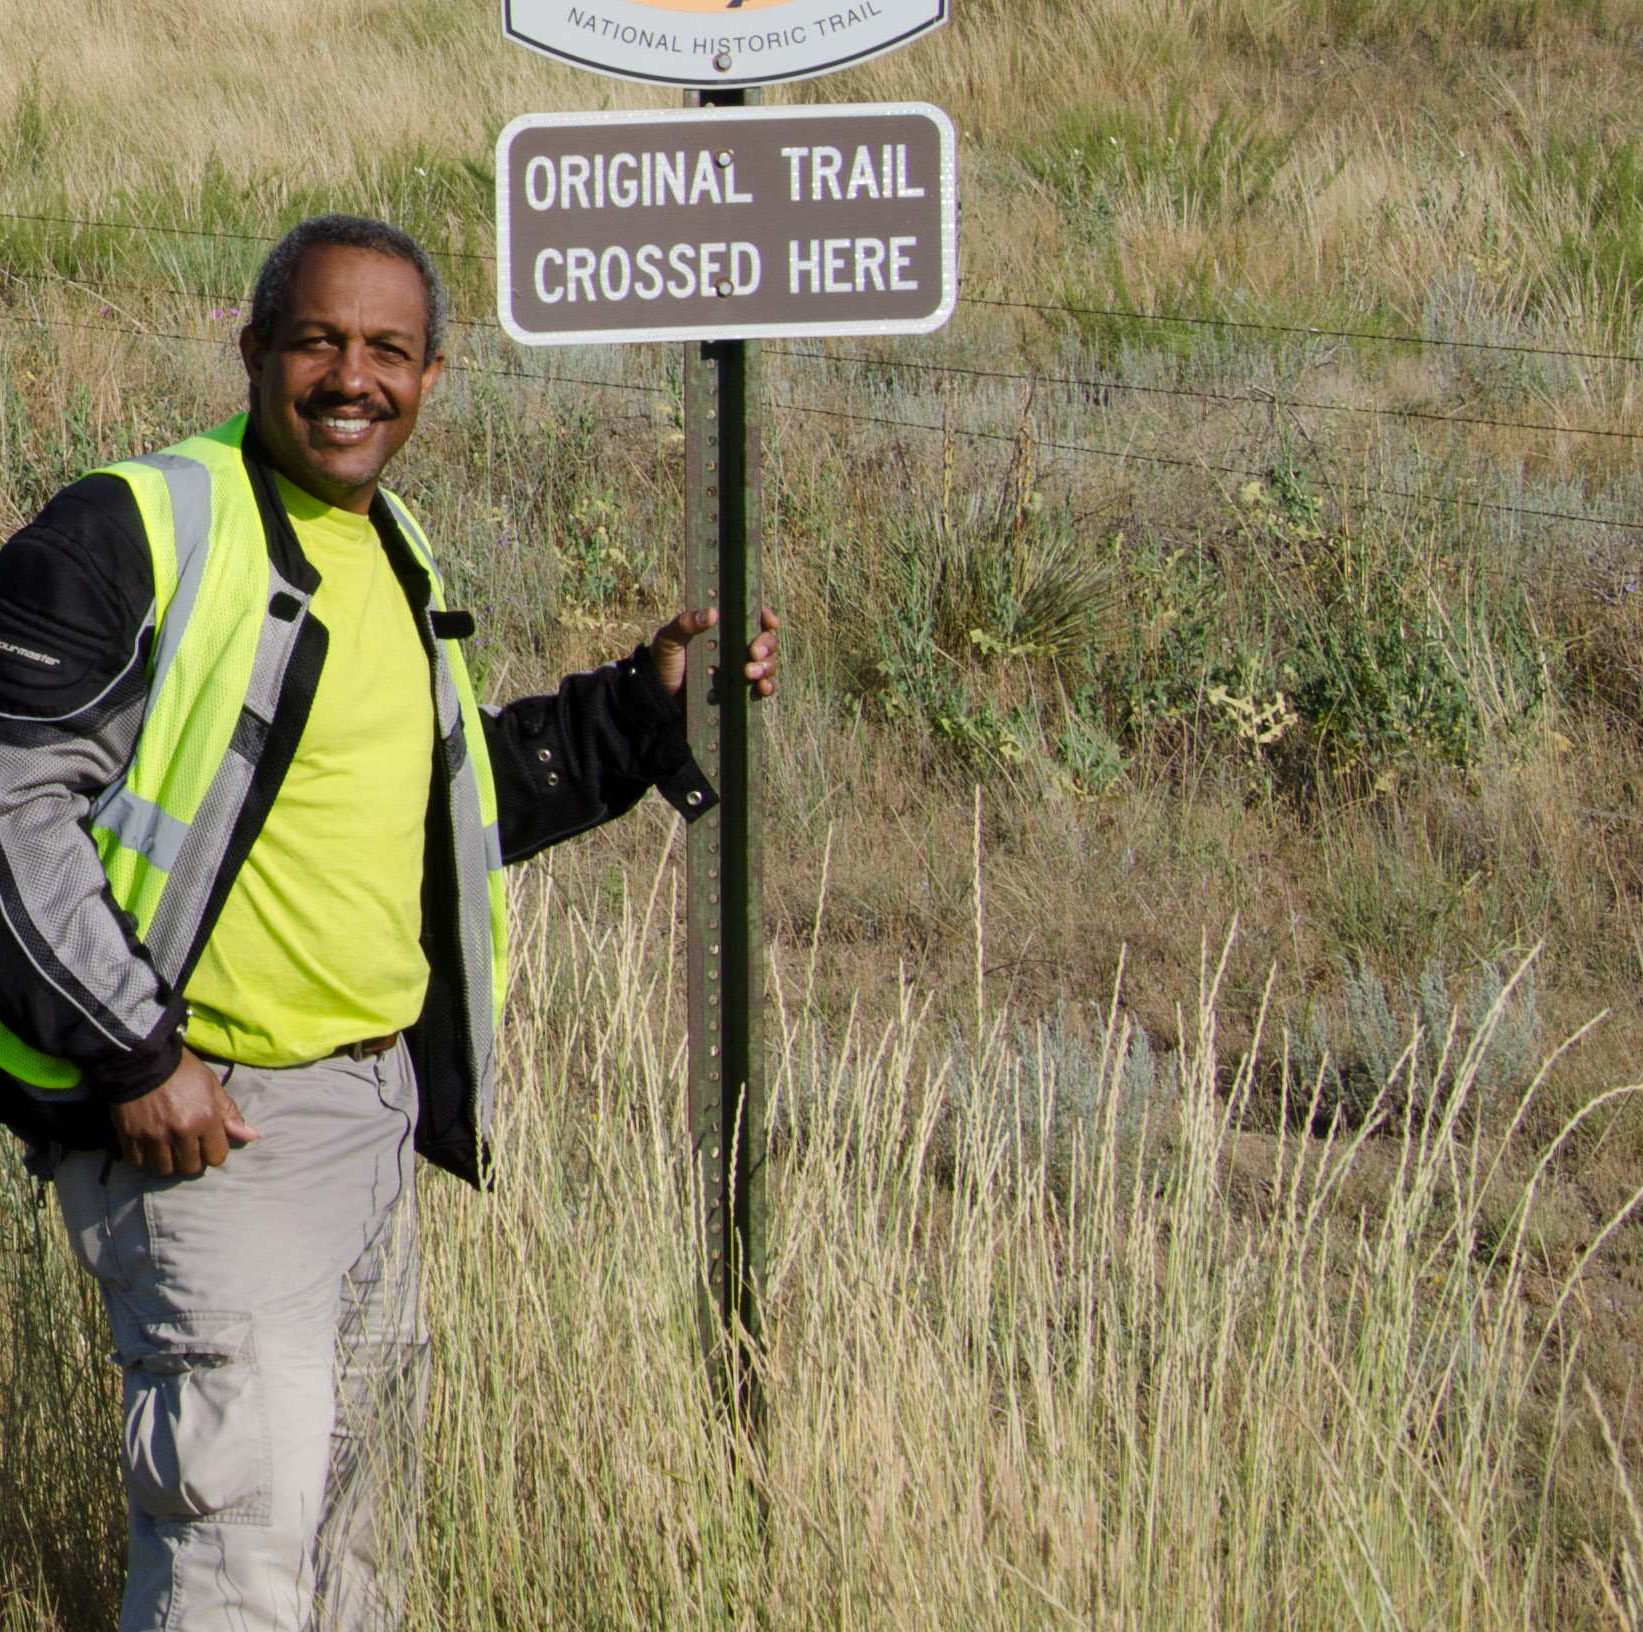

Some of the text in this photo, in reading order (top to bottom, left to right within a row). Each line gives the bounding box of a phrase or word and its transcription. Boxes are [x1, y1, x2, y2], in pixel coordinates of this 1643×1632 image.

[567, 1, 882, 55] NATIONAL HISTORIC TRAIL
[525, 143, 925, 211] ORIGINAL TRAIL
[534, 236, 919, 304] CROSSED HERE
